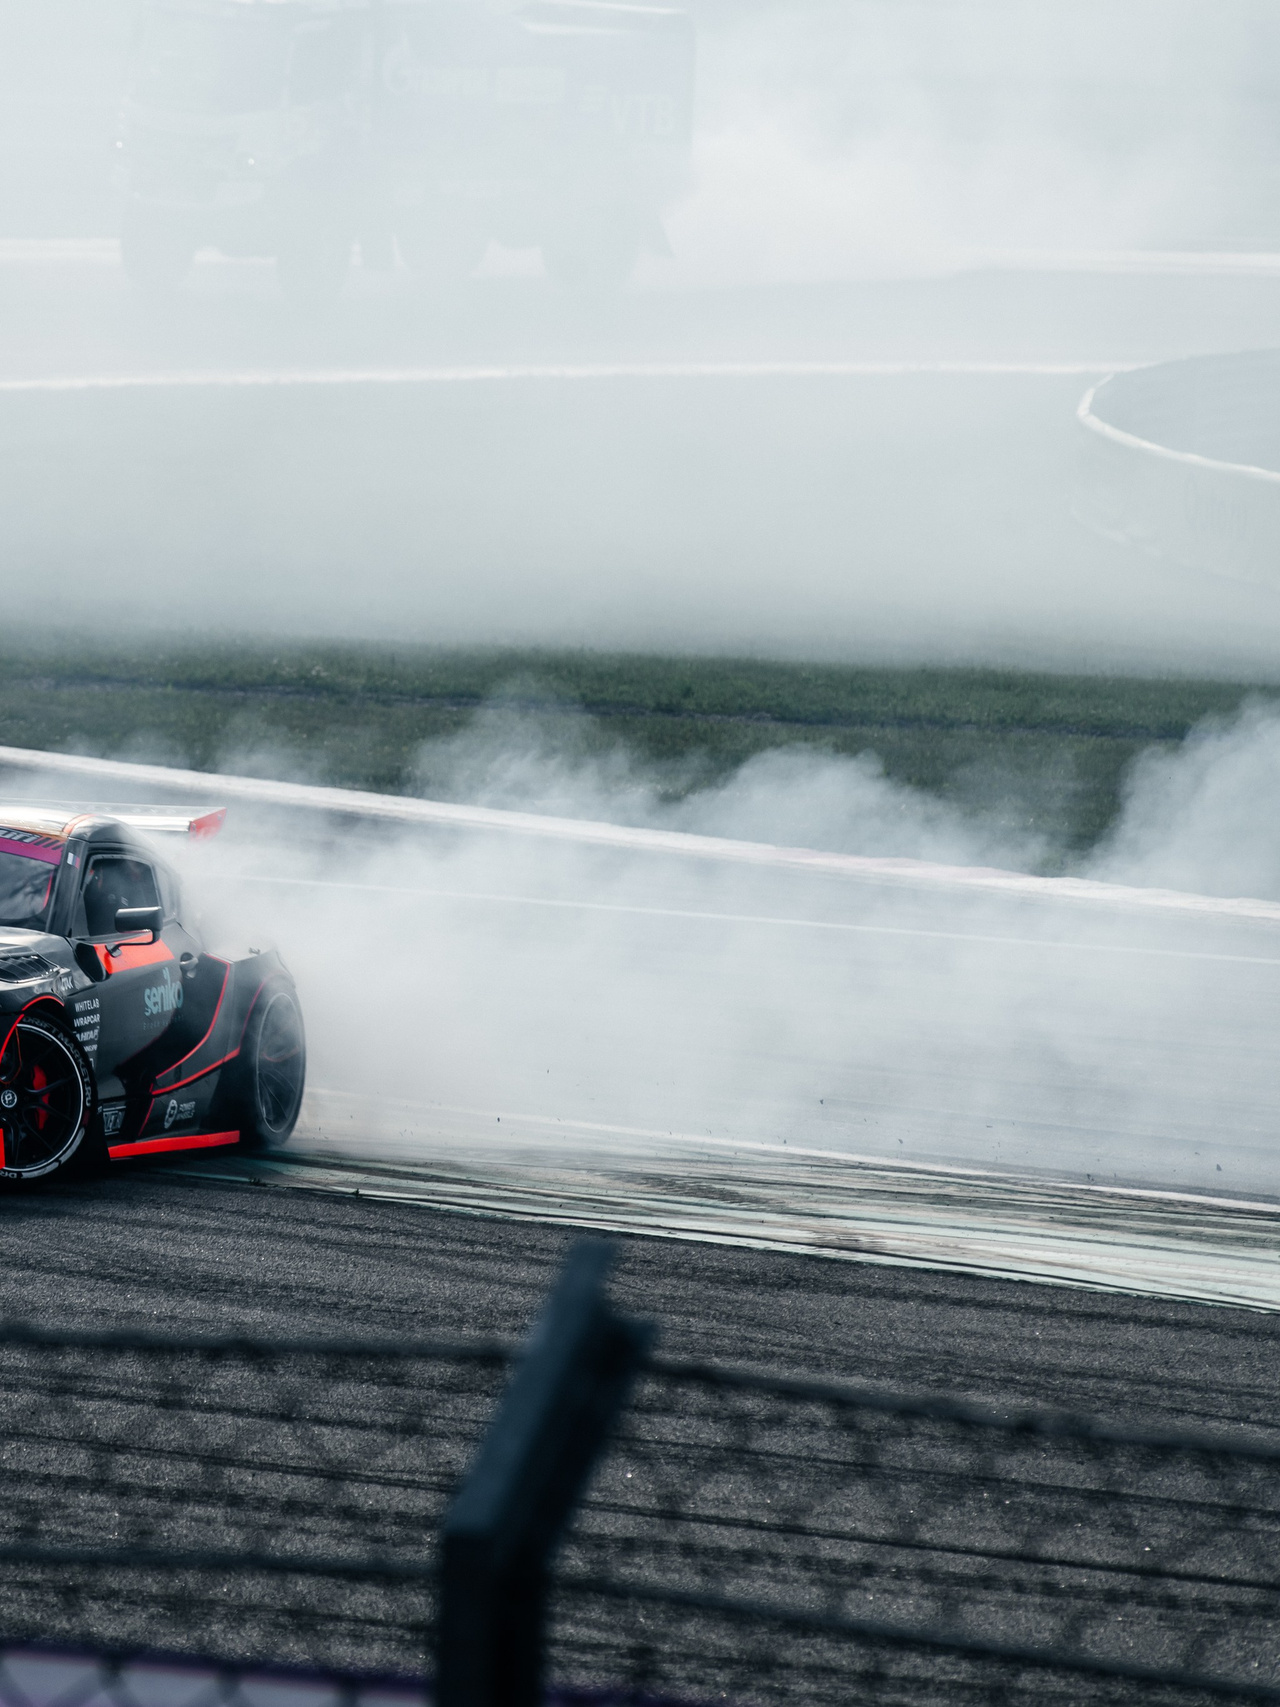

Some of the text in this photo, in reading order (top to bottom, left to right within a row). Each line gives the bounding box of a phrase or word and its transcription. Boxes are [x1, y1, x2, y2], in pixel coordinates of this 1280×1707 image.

[609, 92, 675, 135] VTB
[75, 998, 100, 1013] WHITELAB
[144, 967, 184, 1016] seniko
[73, 1013, 100, 1028] WRAPCAR
